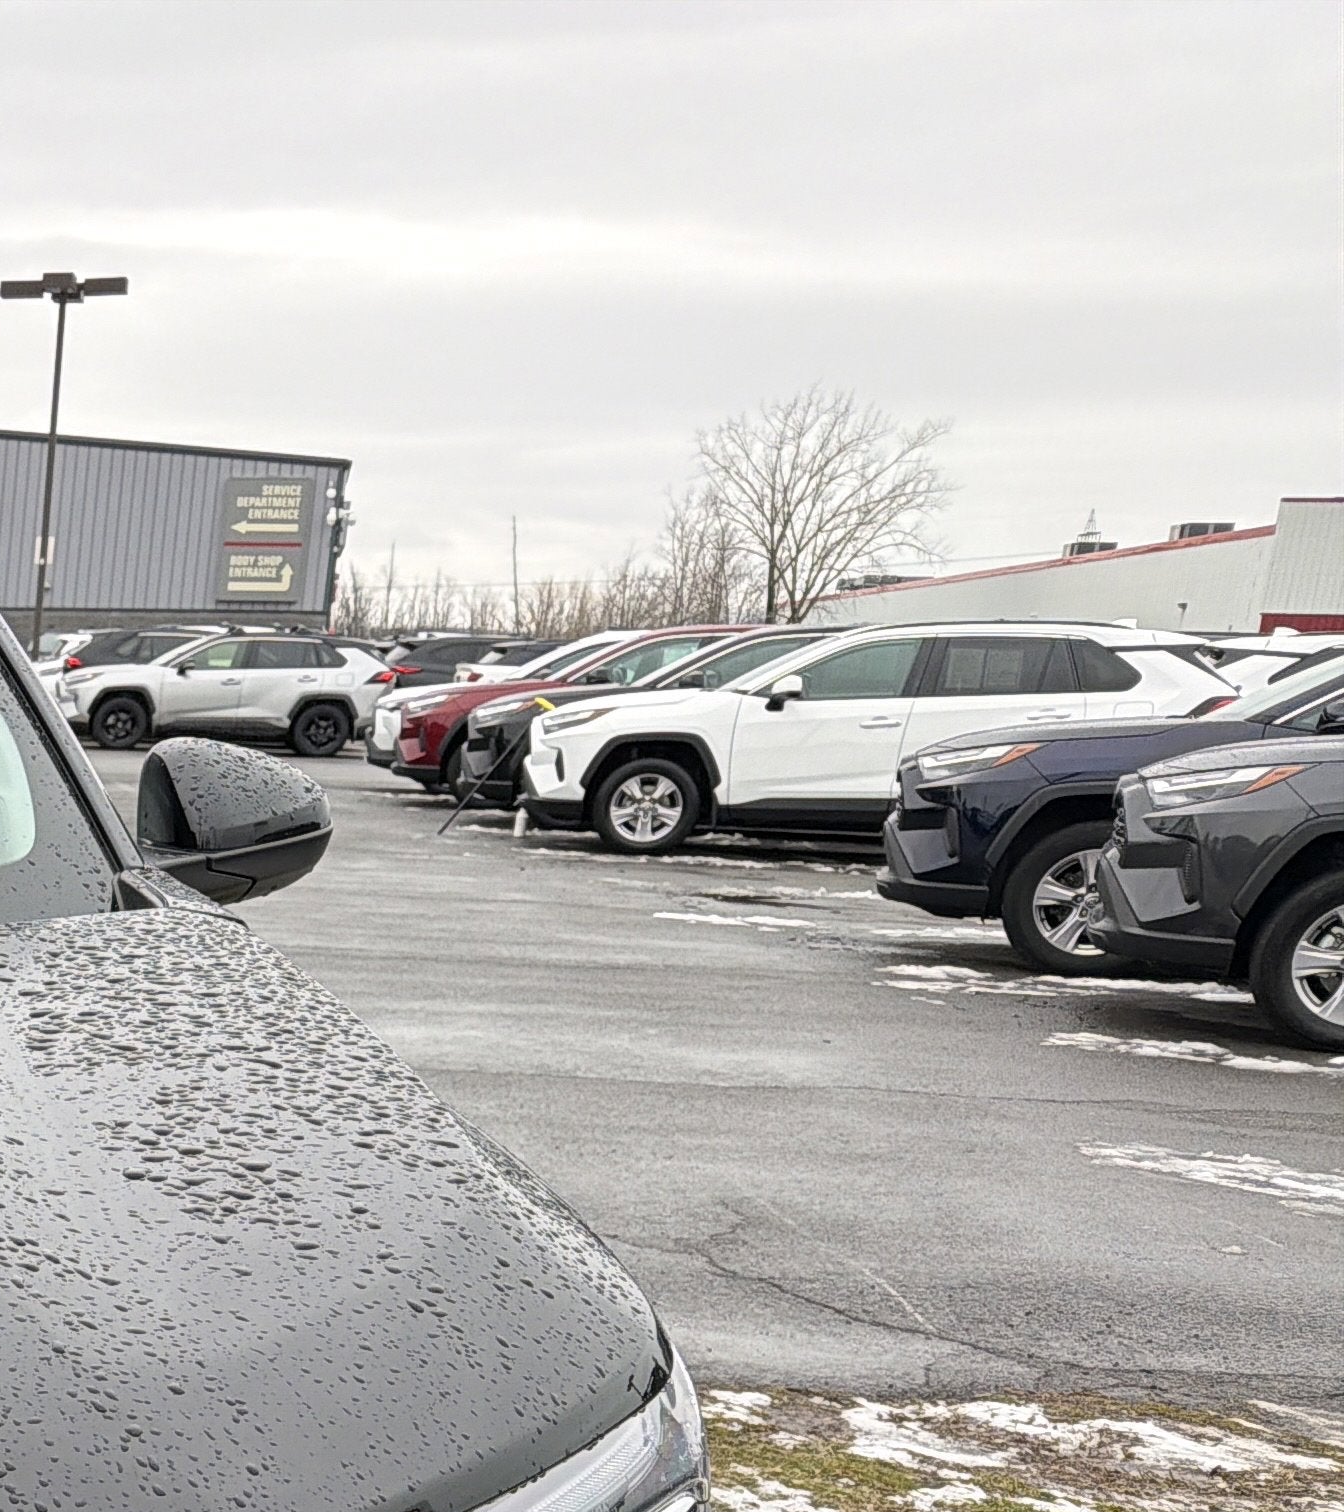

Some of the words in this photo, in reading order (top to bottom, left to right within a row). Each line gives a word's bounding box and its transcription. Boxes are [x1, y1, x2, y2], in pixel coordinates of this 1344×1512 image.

[262, 484, 302, 496] SERVICE
[236, 496, 301, 507] DEPARTMENT
[248, 508, 300, 519] ENTRANCE
[230, 555, 256, 566] BODY
[257, 556, 284, 566] SHOP
[228, 567, 278, 578] ENTRANCE
